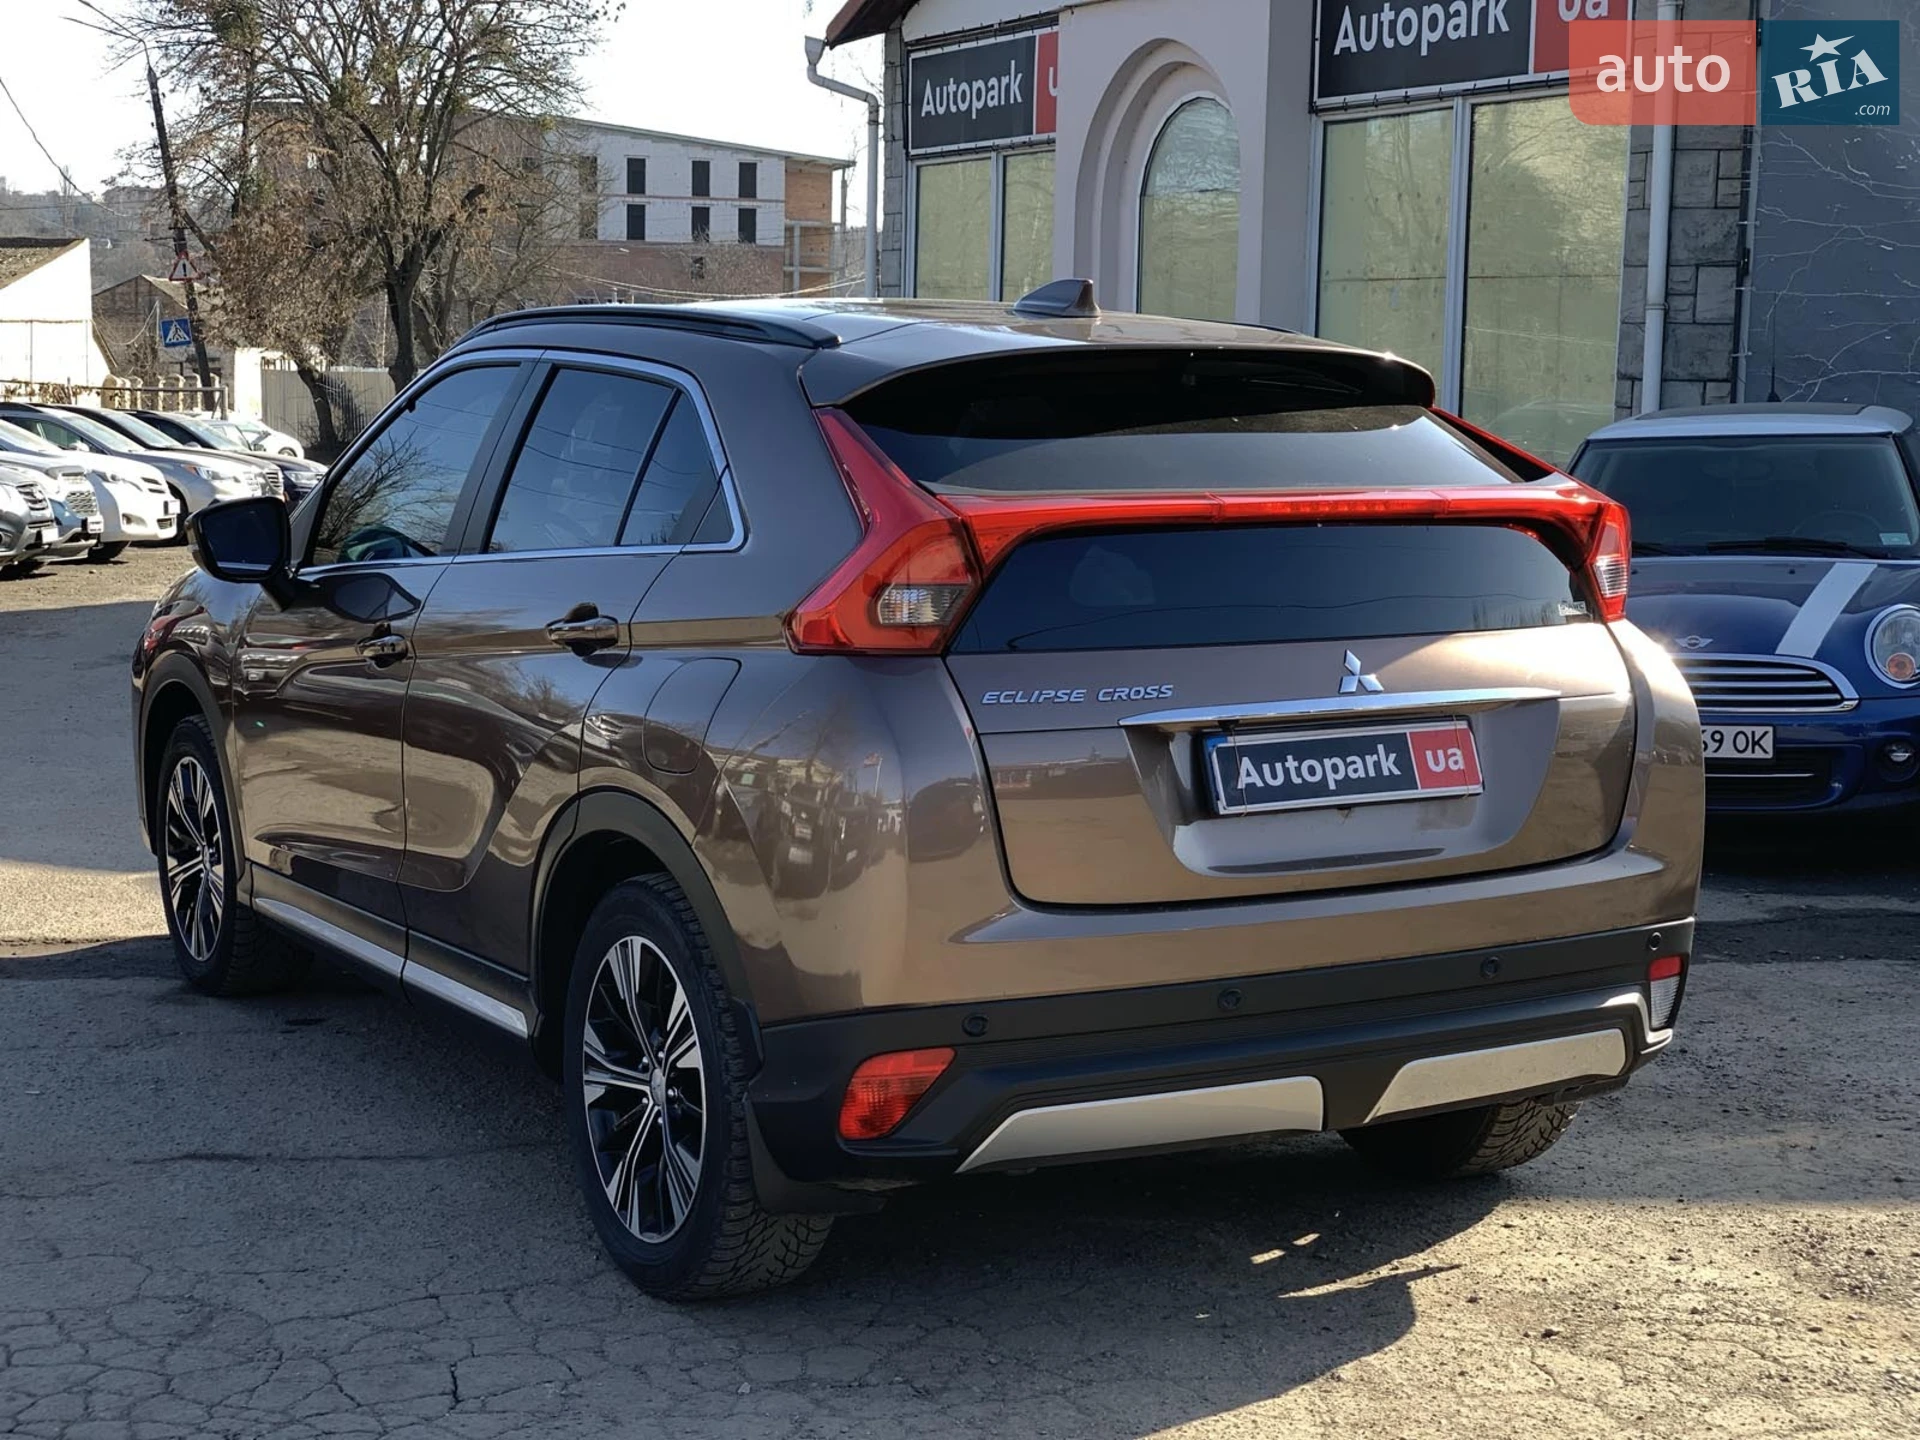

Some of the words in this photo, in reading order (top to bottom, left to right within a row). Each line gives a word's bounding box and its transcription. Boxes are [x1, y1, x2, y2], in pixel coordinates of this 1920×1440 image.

[1333, 0, 1510, 56] Autopark
[921, 59, 1023, 120] Autopark
[1048, 66, 1059, 97] u
[982, 689, 1087, 704] ECLIPSE
[1097, 684, 1174, 701] CROSS
[1732, 729, 1770, 755] OK
[1237, 744, 1402, 790] Autopark
[1425, 746, 1465, 773] ua
